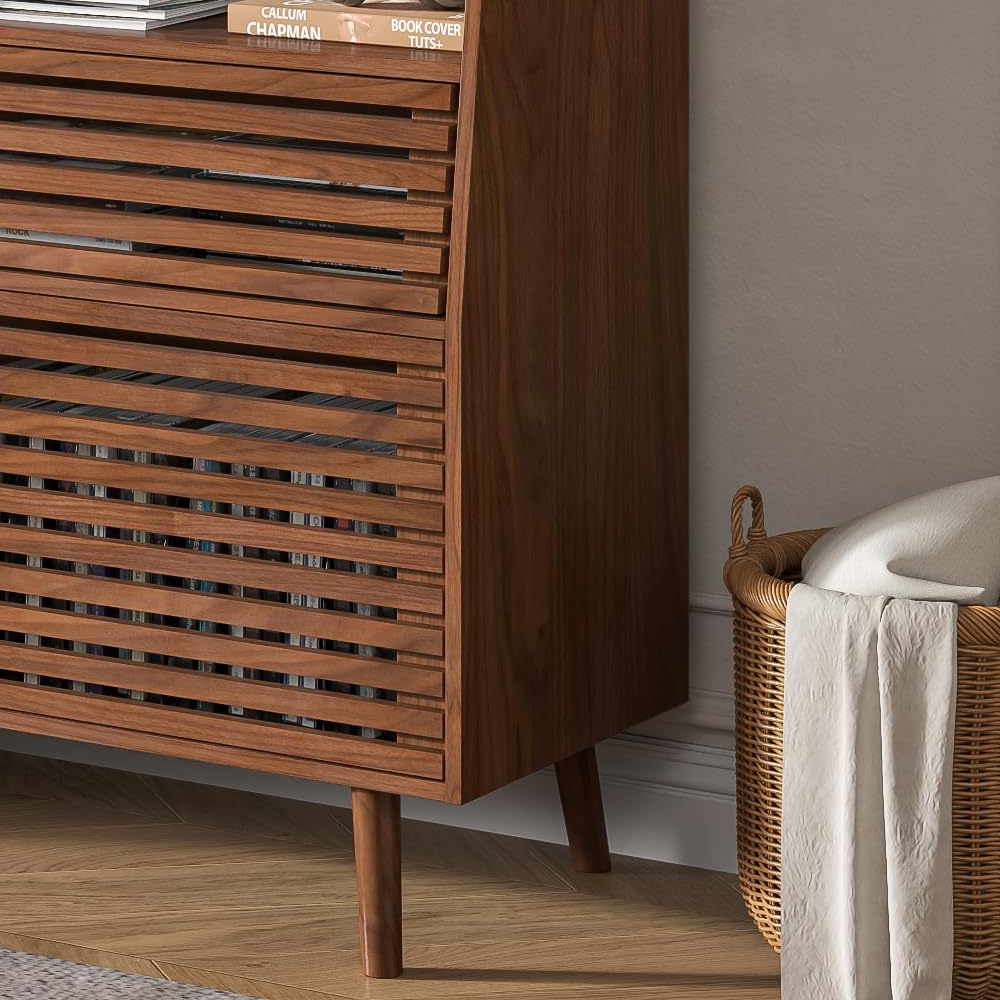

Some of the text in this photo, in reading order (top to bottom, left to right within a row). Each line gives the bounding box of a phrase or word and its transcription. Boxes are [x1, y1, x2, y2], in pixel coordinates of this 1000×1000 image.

[261, 6, 307, 21] CALLUM
[246, 21, 321, 41] CHAPMAN
[391, 19, 462, 37] BOOK COVER
[408, 35, 444, 50] TUTS+
